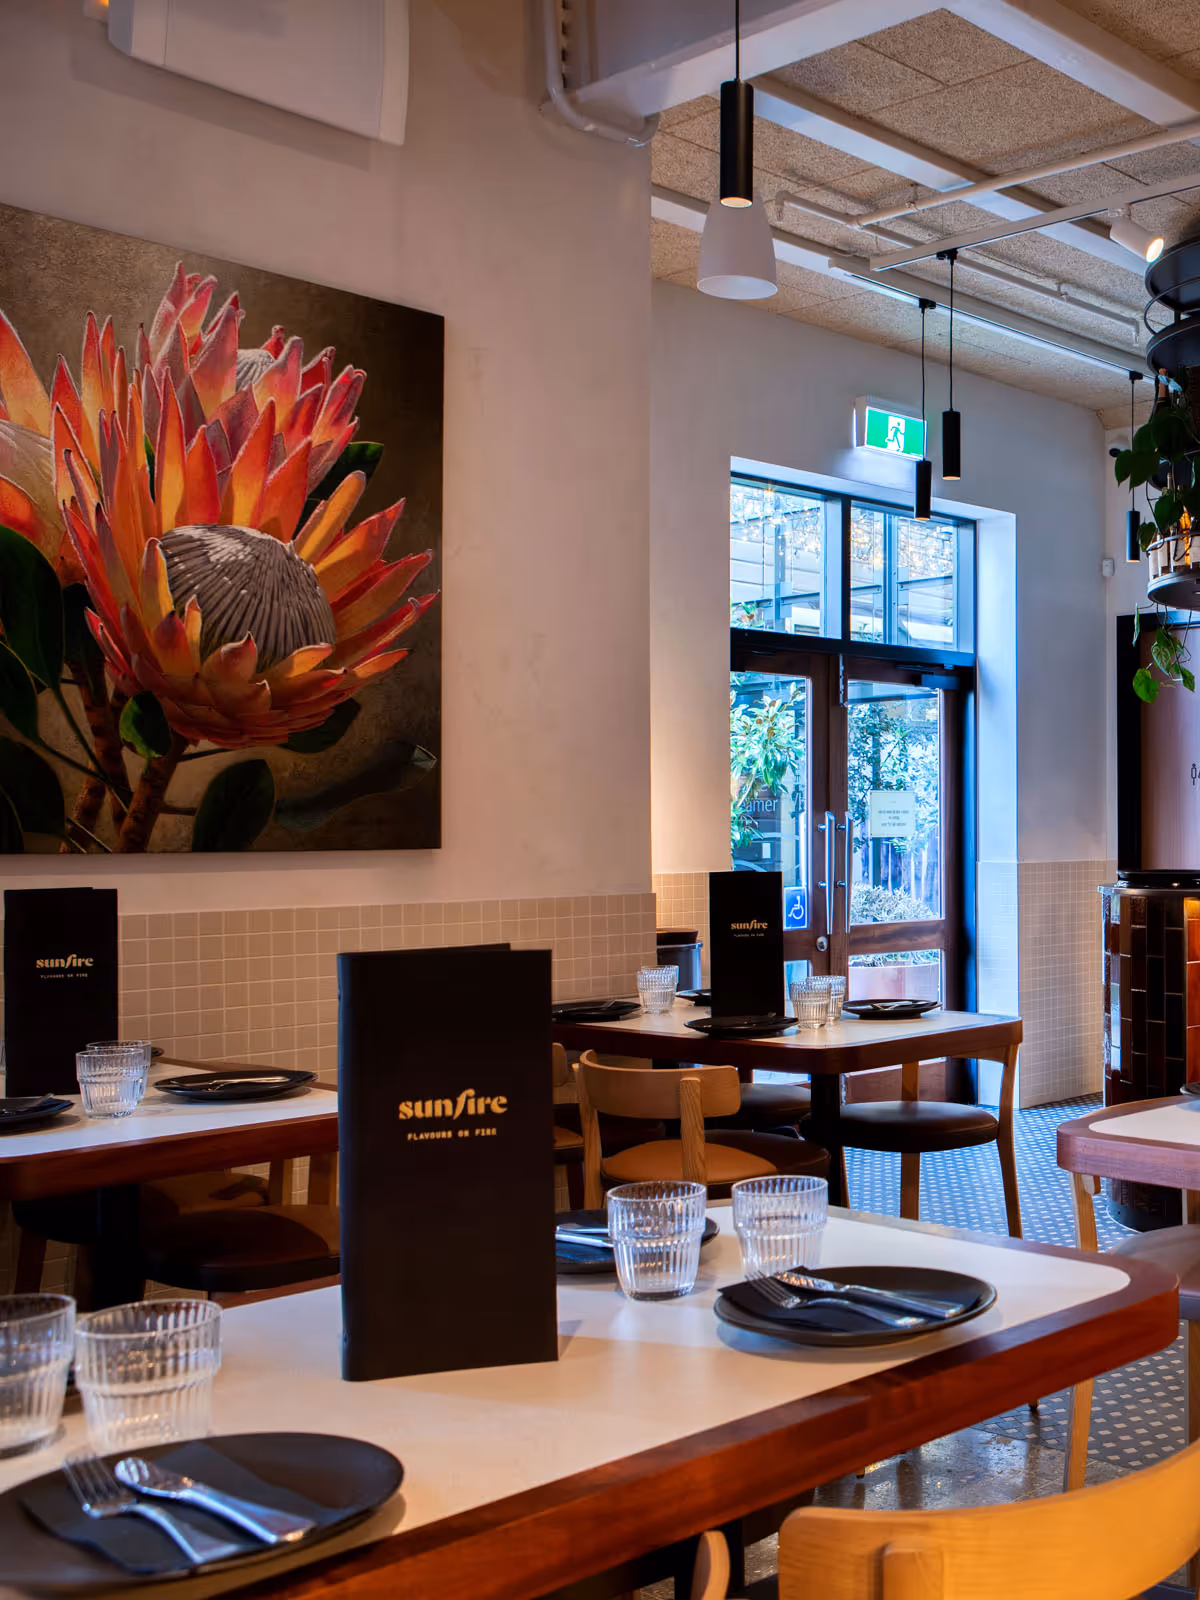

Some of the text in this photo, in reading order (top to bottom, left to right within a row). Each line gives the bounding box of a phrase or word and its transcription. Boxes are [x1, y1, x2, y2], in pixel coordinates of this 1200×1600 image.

[730, 919, 769, 931] sunfire
[35, 953, 94, 969] sunfire
[398, 1088, 508, 1120] sunfire
[407, 1130, 453, 1141] FLAVOURS
